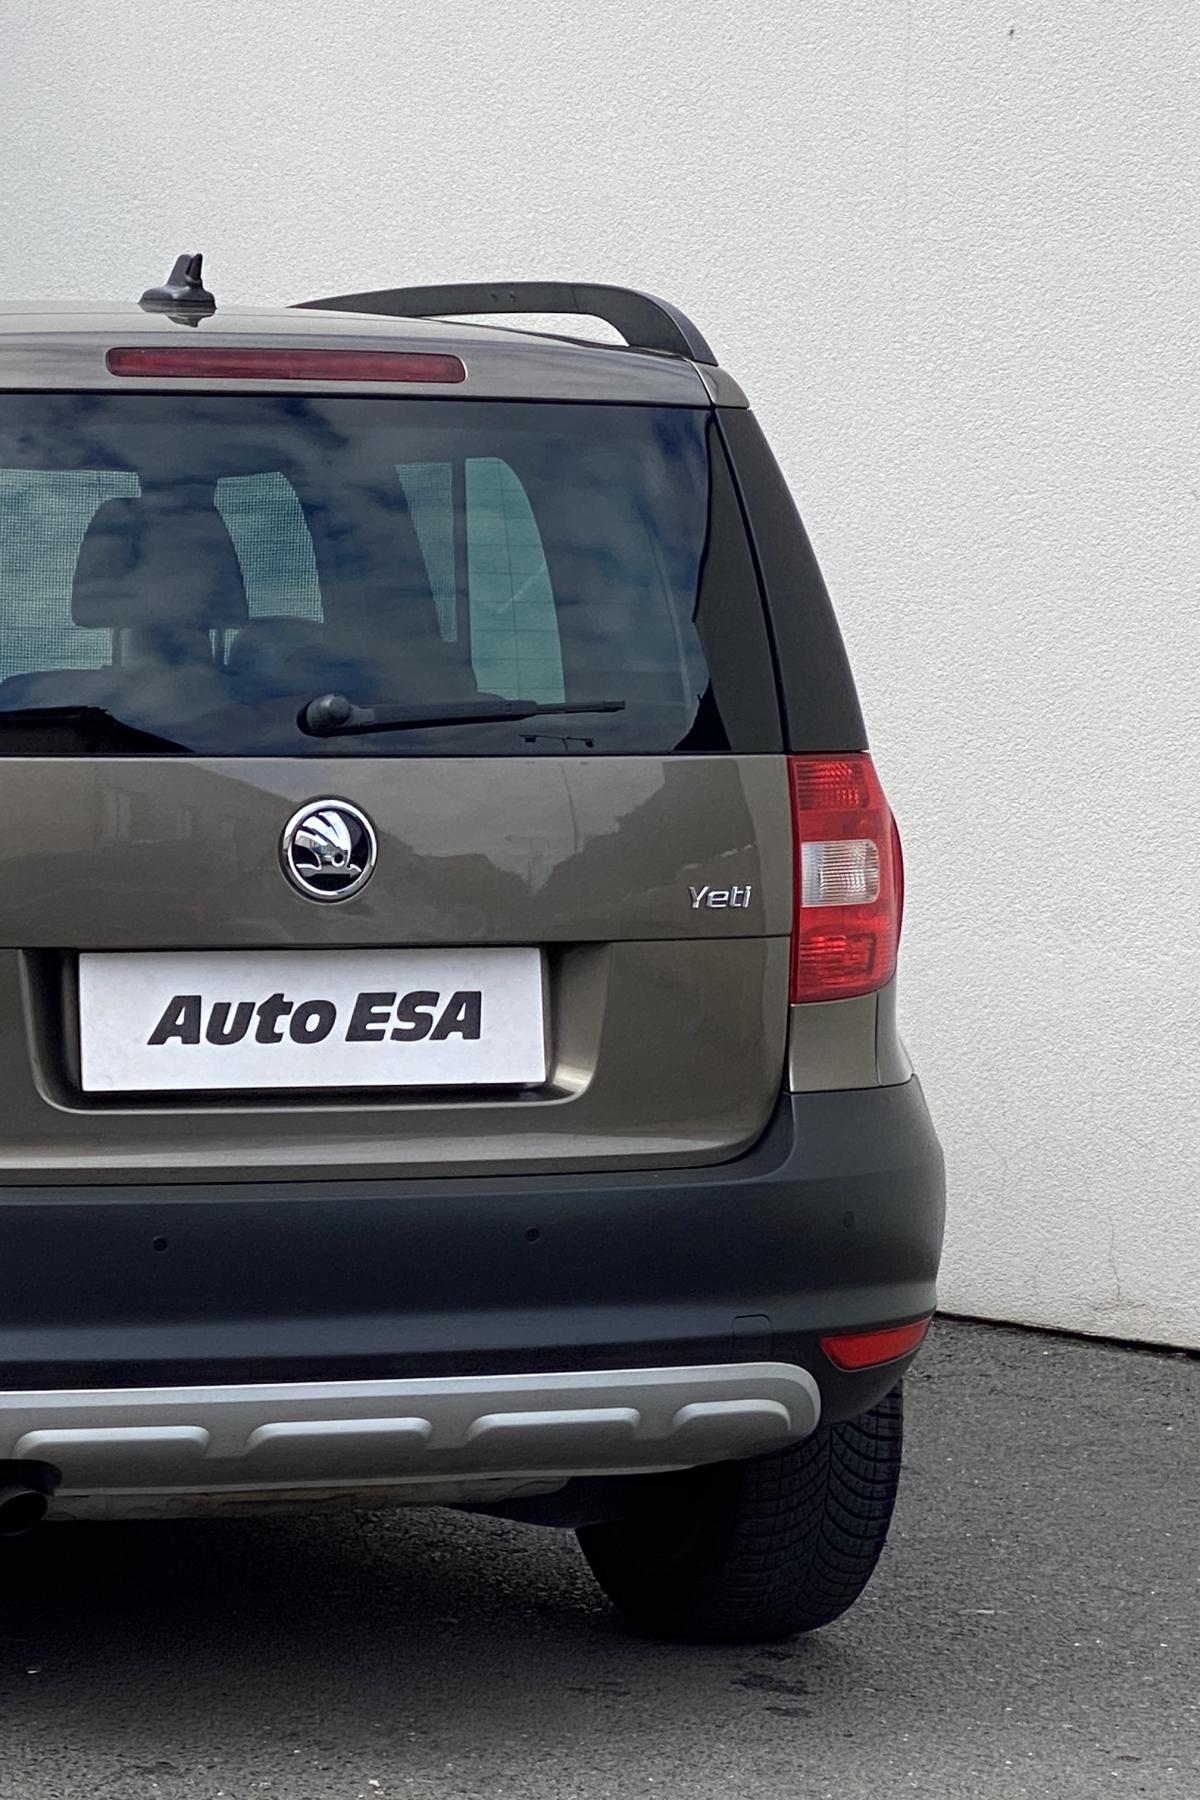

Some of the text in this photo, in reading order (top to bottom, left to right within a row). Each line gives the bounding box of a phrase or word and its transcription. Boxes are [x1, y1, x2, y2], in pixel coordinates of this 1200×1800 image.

[688, 885, 752, 908] Yeti
[146, 990, 482, 1046] Auto ESA
